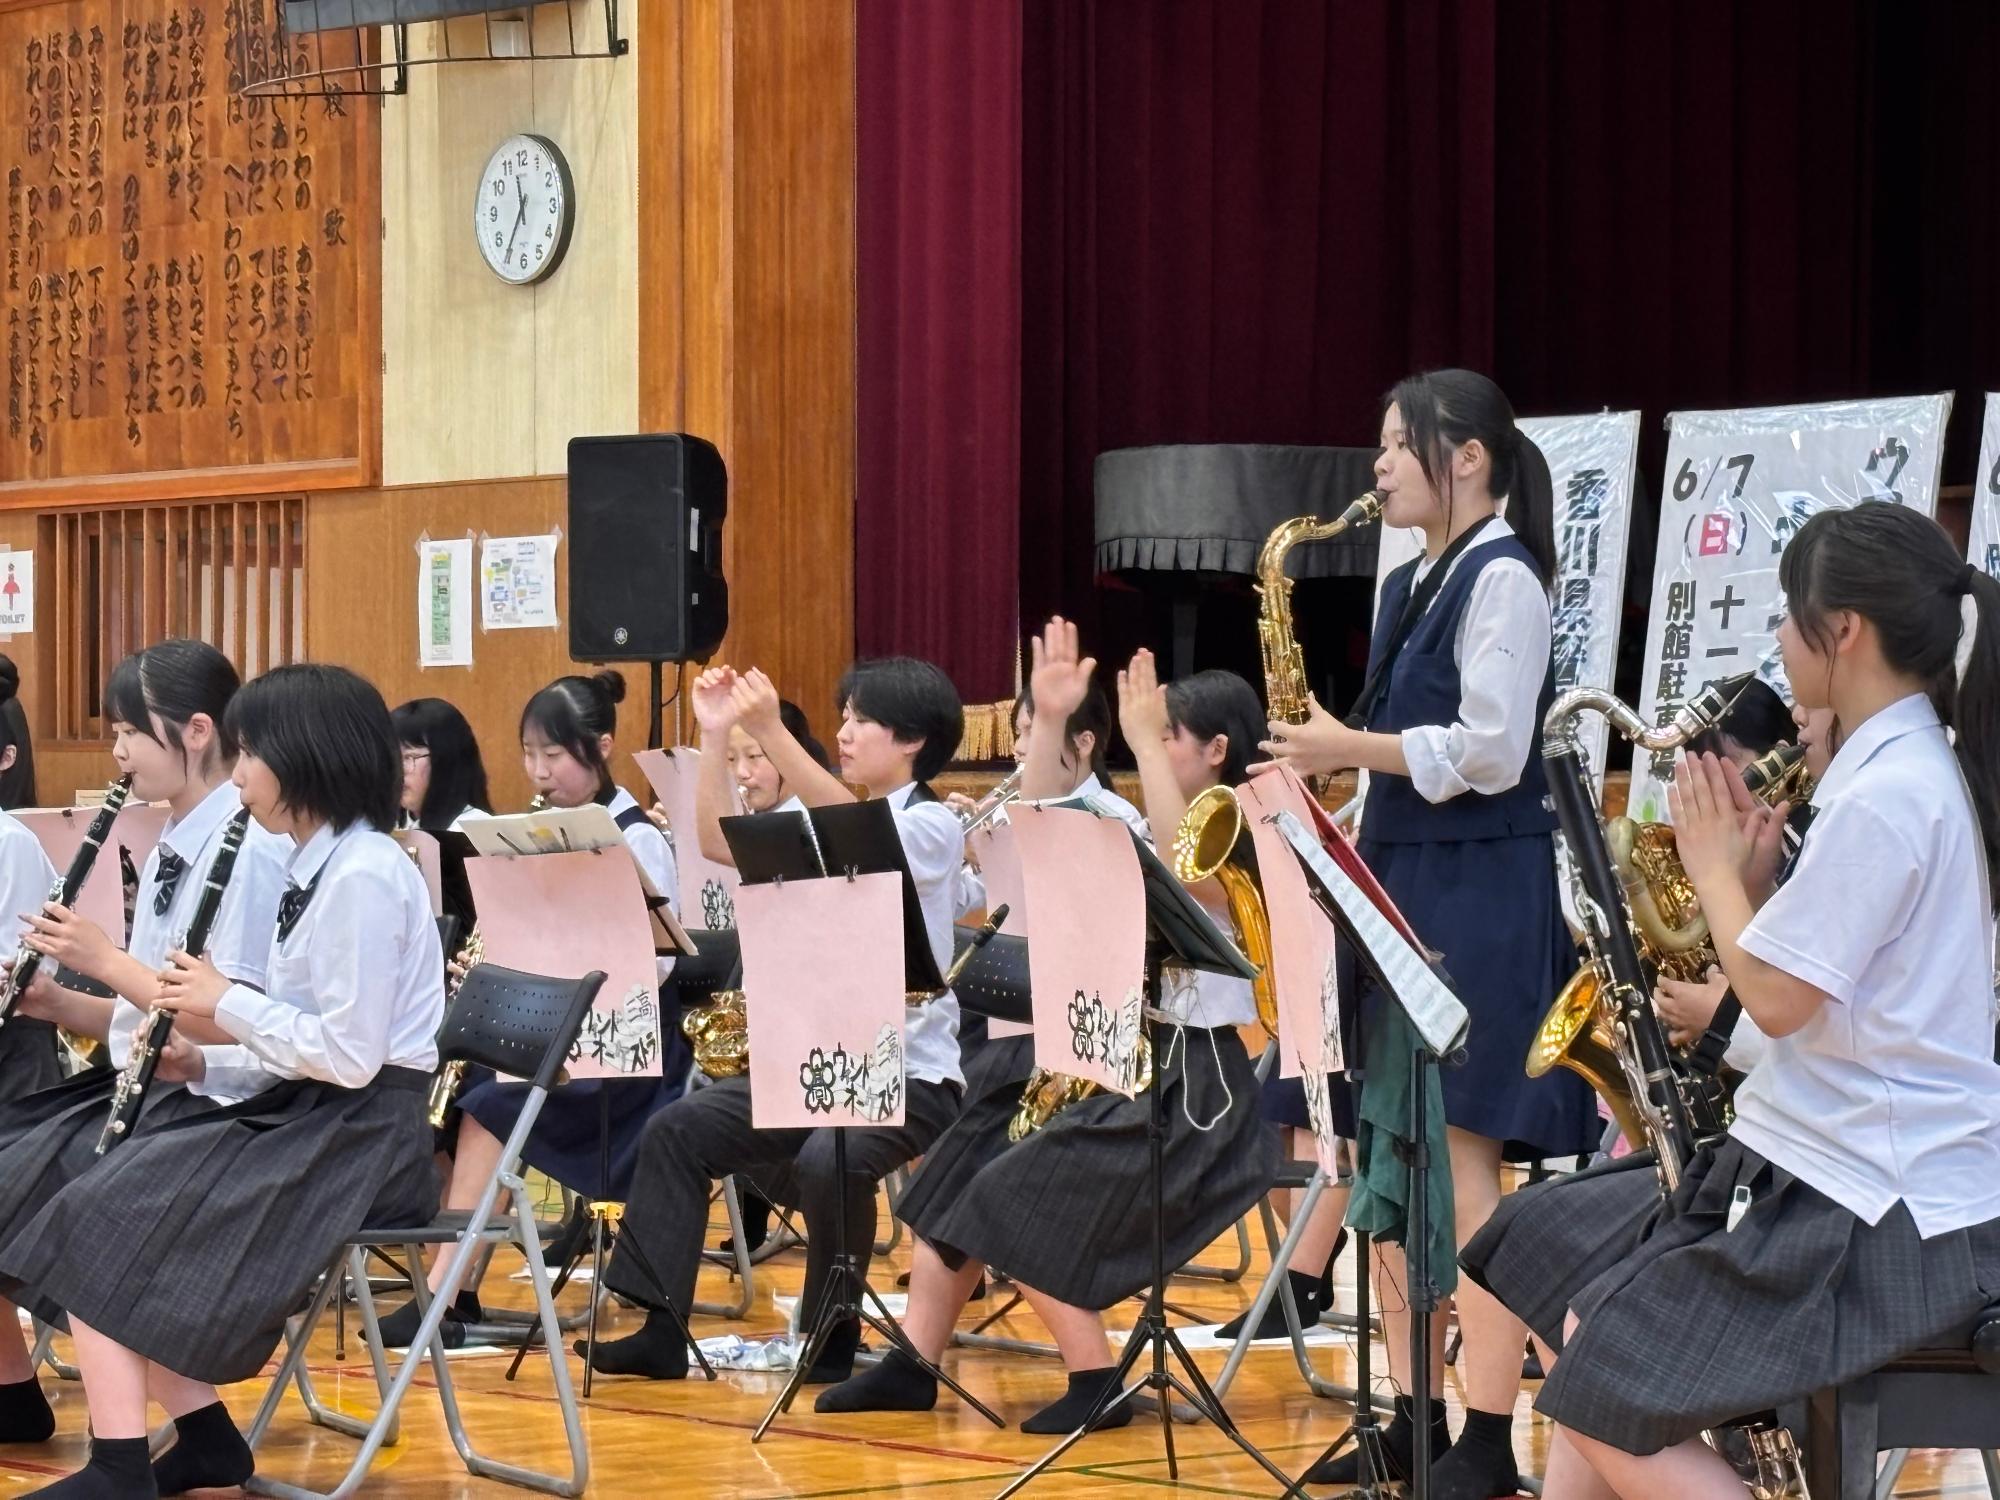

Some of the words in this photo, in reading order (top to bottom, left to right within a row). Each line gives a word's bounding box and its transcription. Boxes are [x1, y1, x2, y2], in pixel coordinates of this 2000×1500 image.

[516, 150, 528, 167] 12
[545, 172, 552, 187] 2
[493, 180, 505, 196] 10
[490, 206, 498, 222] 9
[549, 198, 557, 214] 3
[325, 209, 347, 246] 歌
[520, 254, 528, 269] 6
[1672, 454, 1754, 502] 6/7
[1684, 512, 1748, 557] (日)
